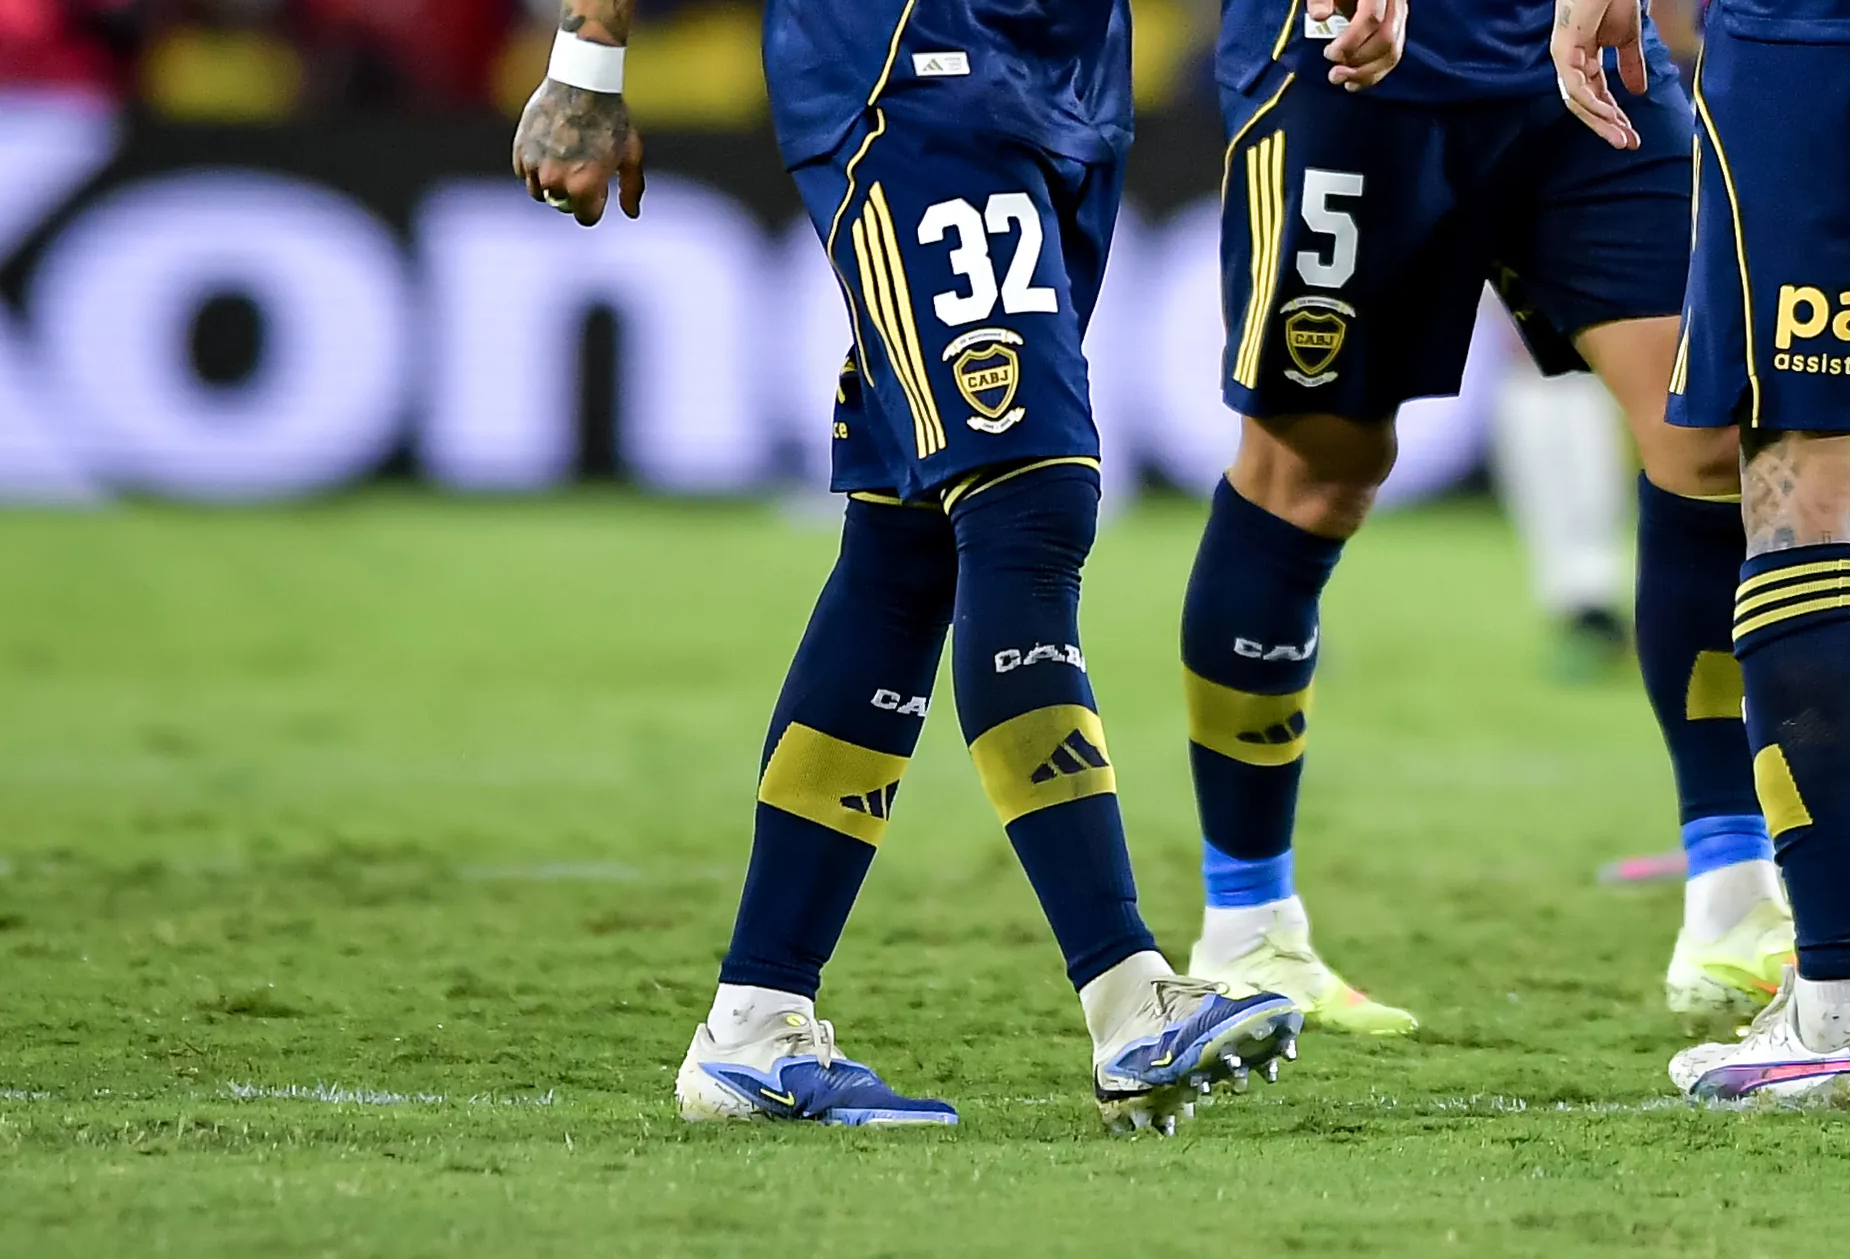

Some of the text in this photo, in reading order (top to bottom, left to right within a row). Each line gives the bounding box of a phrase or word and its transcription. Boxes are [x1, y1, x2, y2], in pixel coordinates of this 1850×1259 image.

[917, 192, 1059, 326] 32
[1296, 168, 1365, 289] 5
[967, 369, 1010, 389] CABJ
